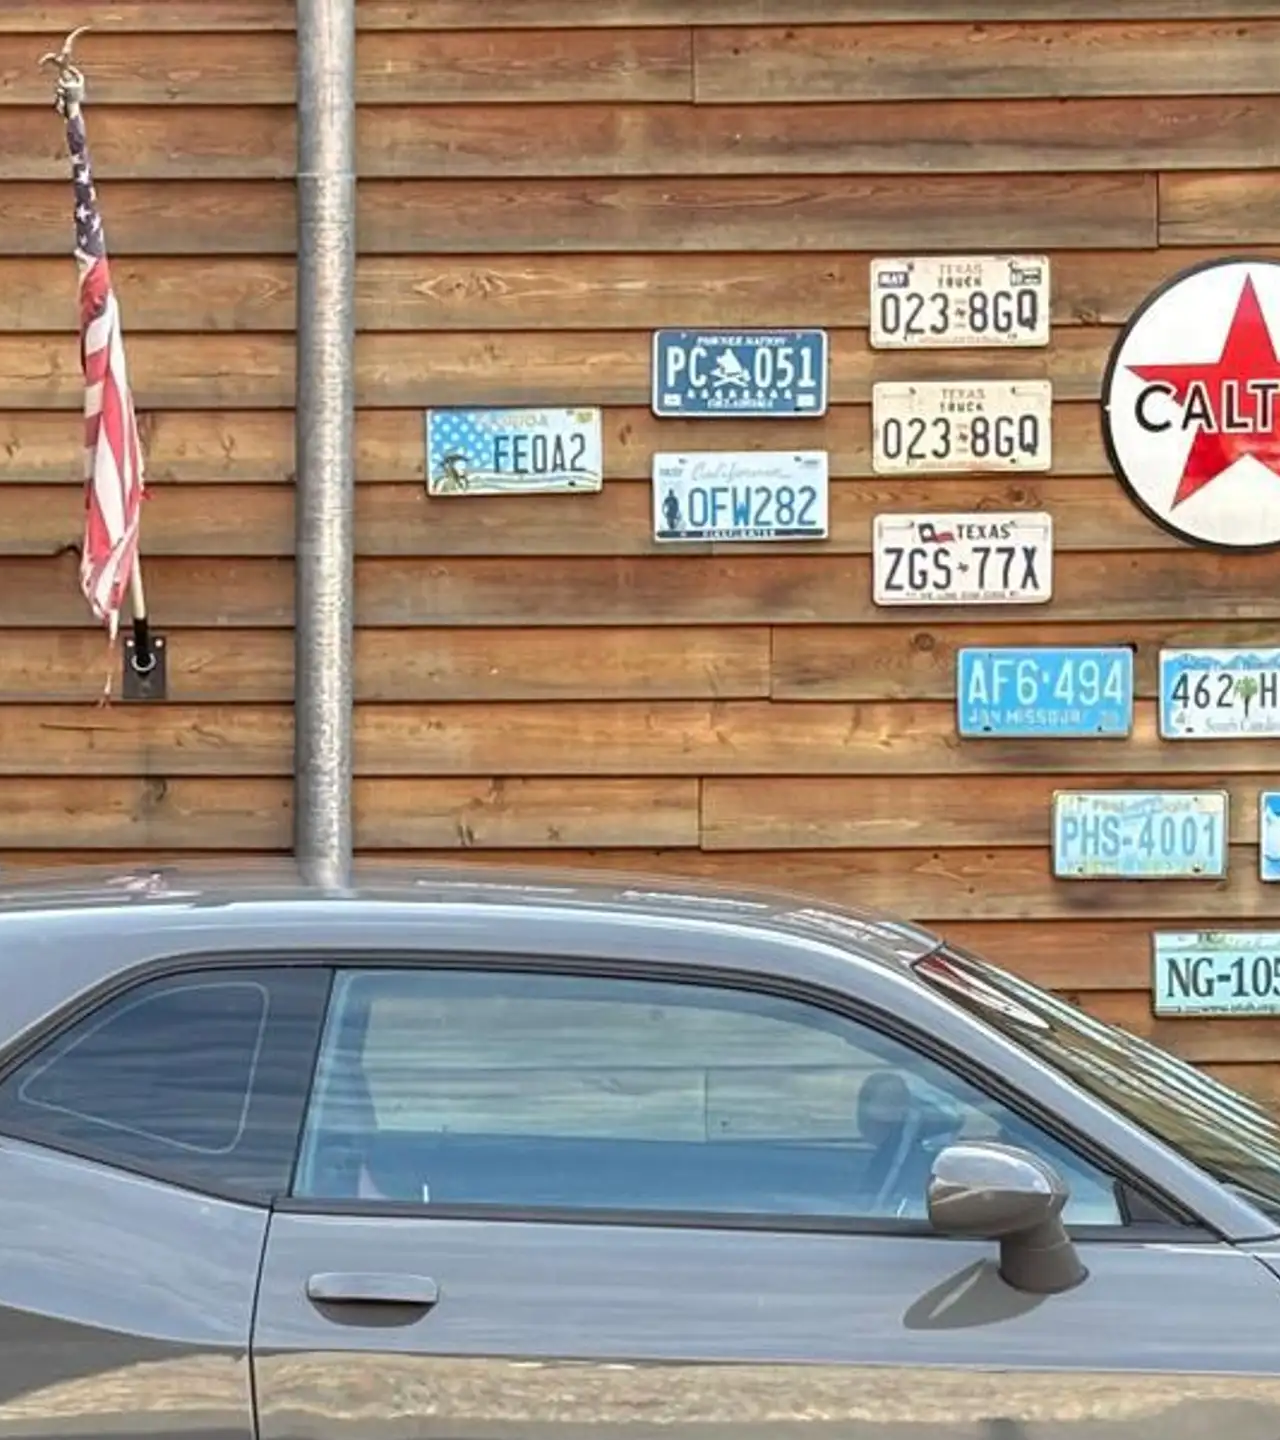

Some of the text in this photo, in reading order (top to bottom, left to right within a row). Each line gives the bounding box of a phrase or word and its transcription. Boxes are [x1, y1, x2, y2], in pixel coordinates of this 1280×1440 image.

[666, 345, 708, 388] PC
[956, 523, 1011, 540] TEXAS
[1172, 672, 1234, 709] 462
